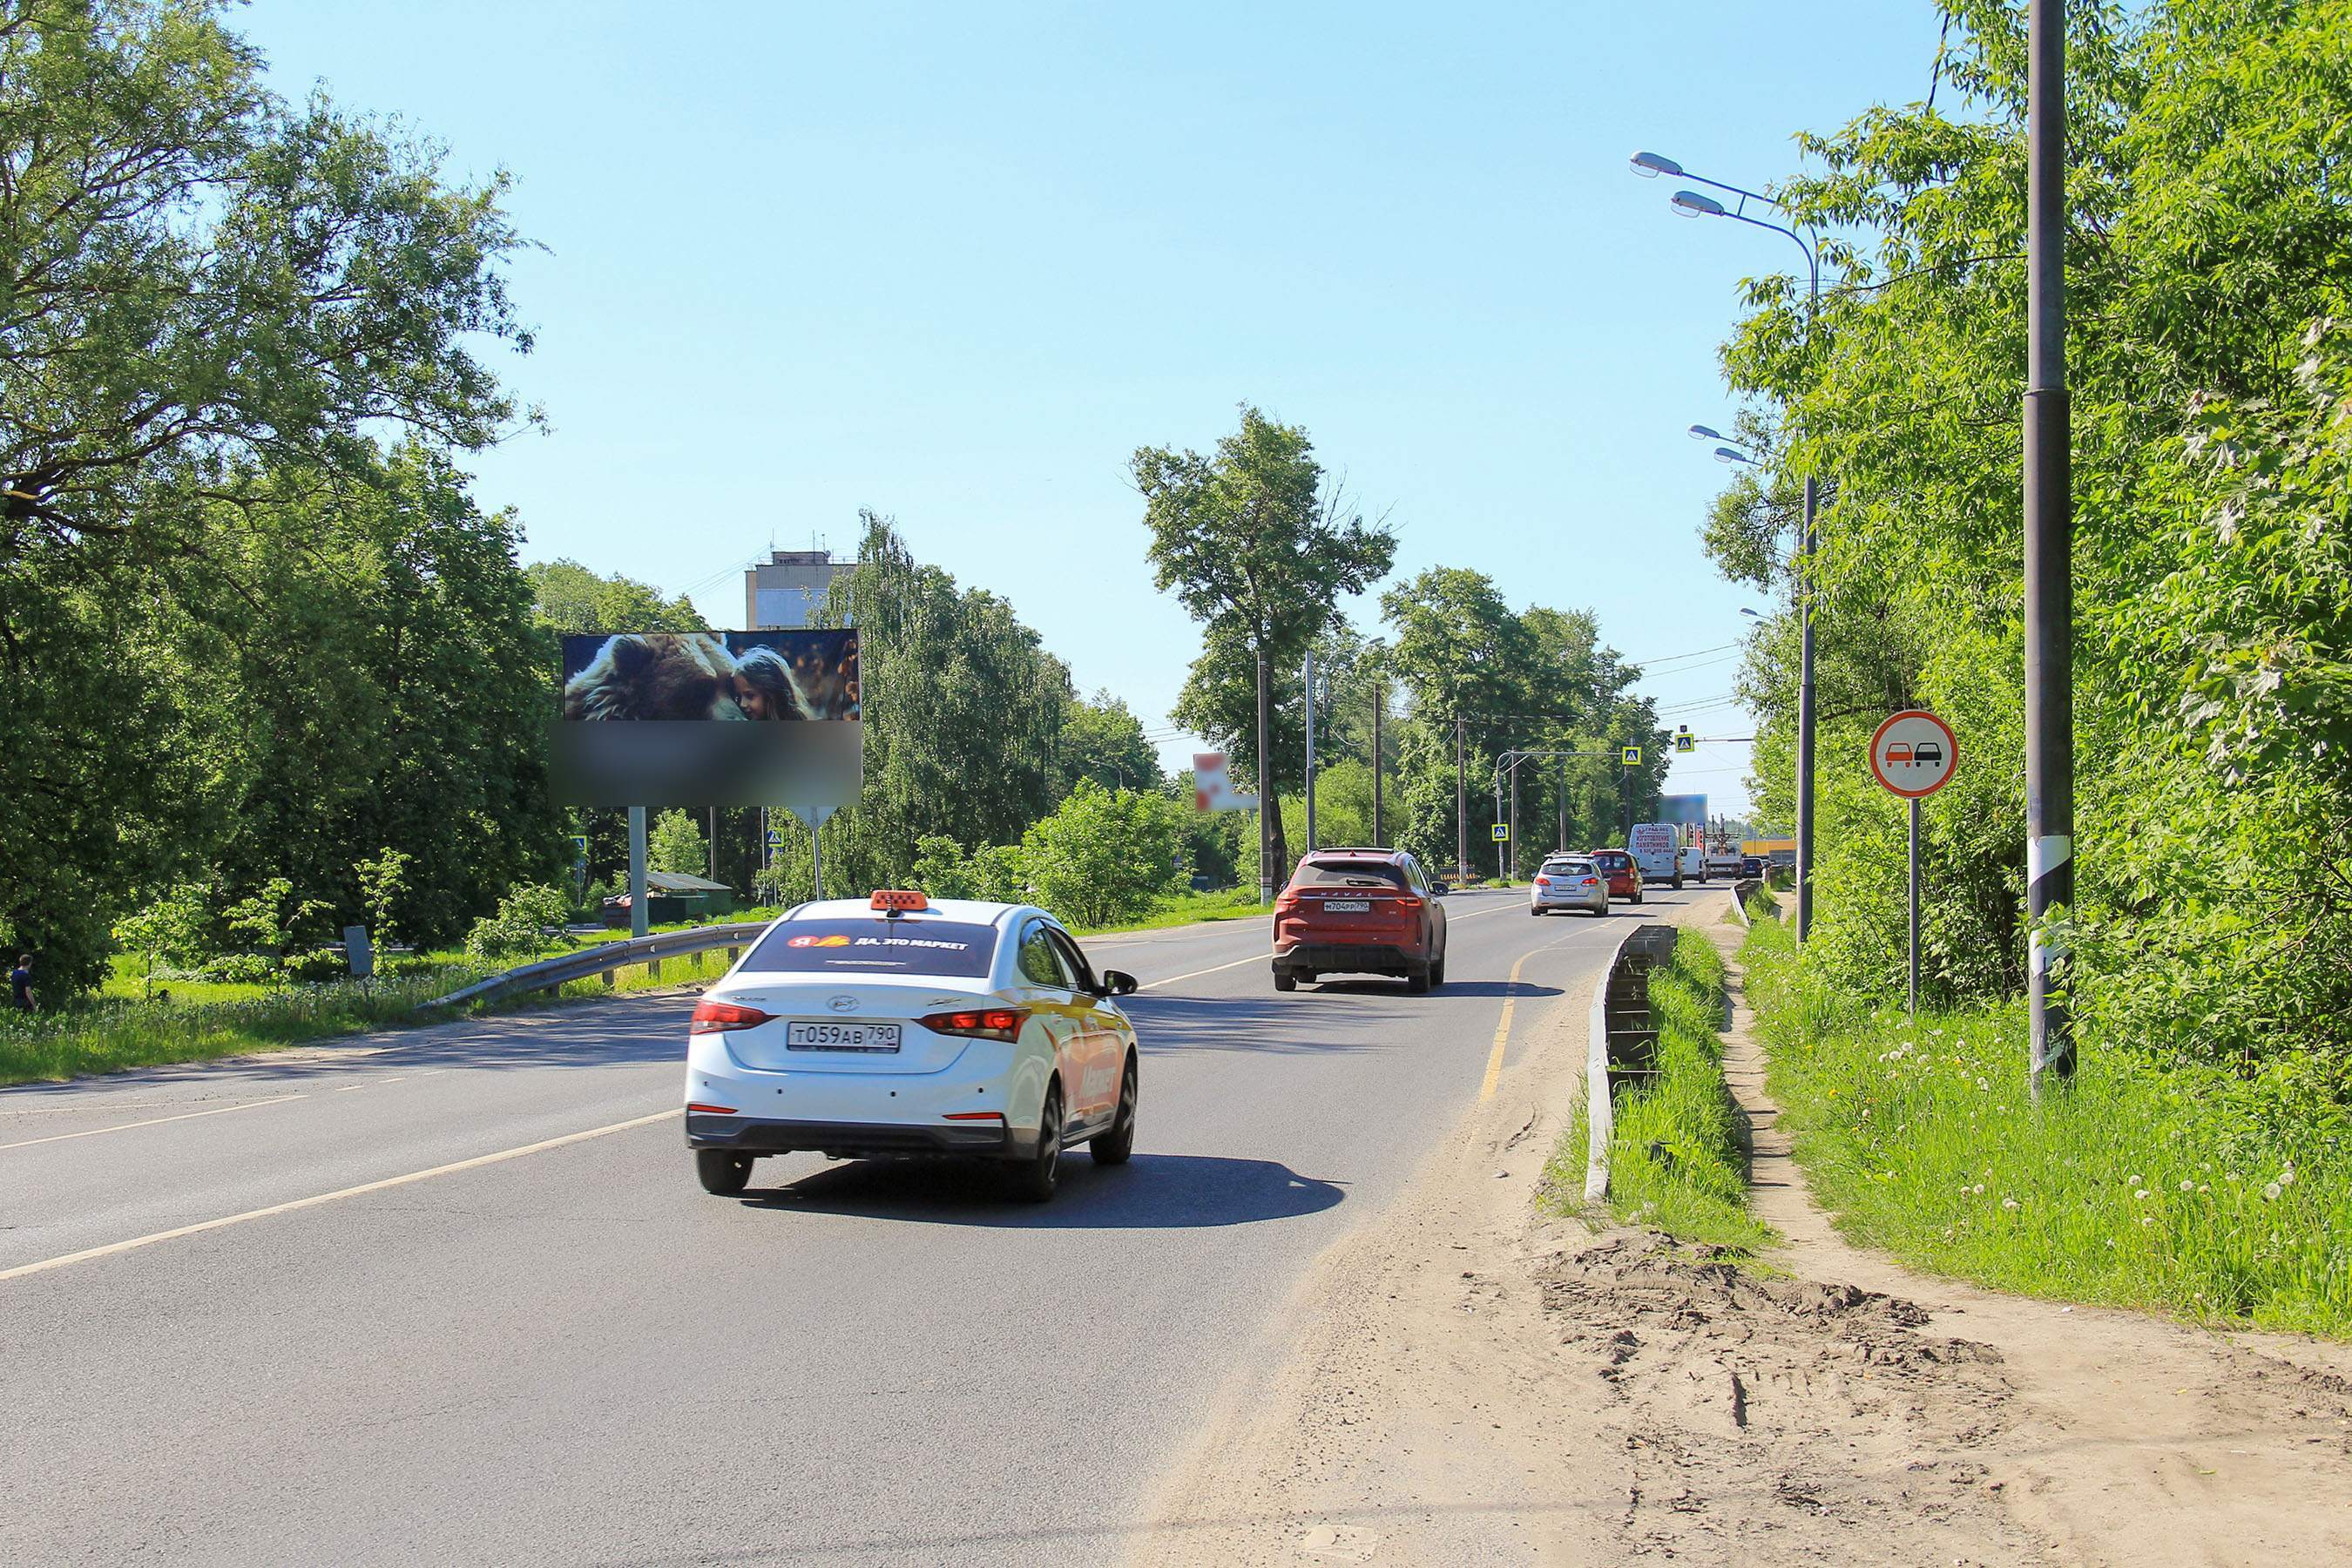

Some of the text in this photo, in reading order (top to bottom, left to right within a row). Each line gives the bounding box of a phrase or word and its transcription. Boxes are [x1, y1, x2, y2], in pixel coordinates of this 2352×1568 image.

[794, 937, 811, 947] Я
[854, 937, 881, 946] ДА,
[909, 939, 969, 950] МАРКЕТ
